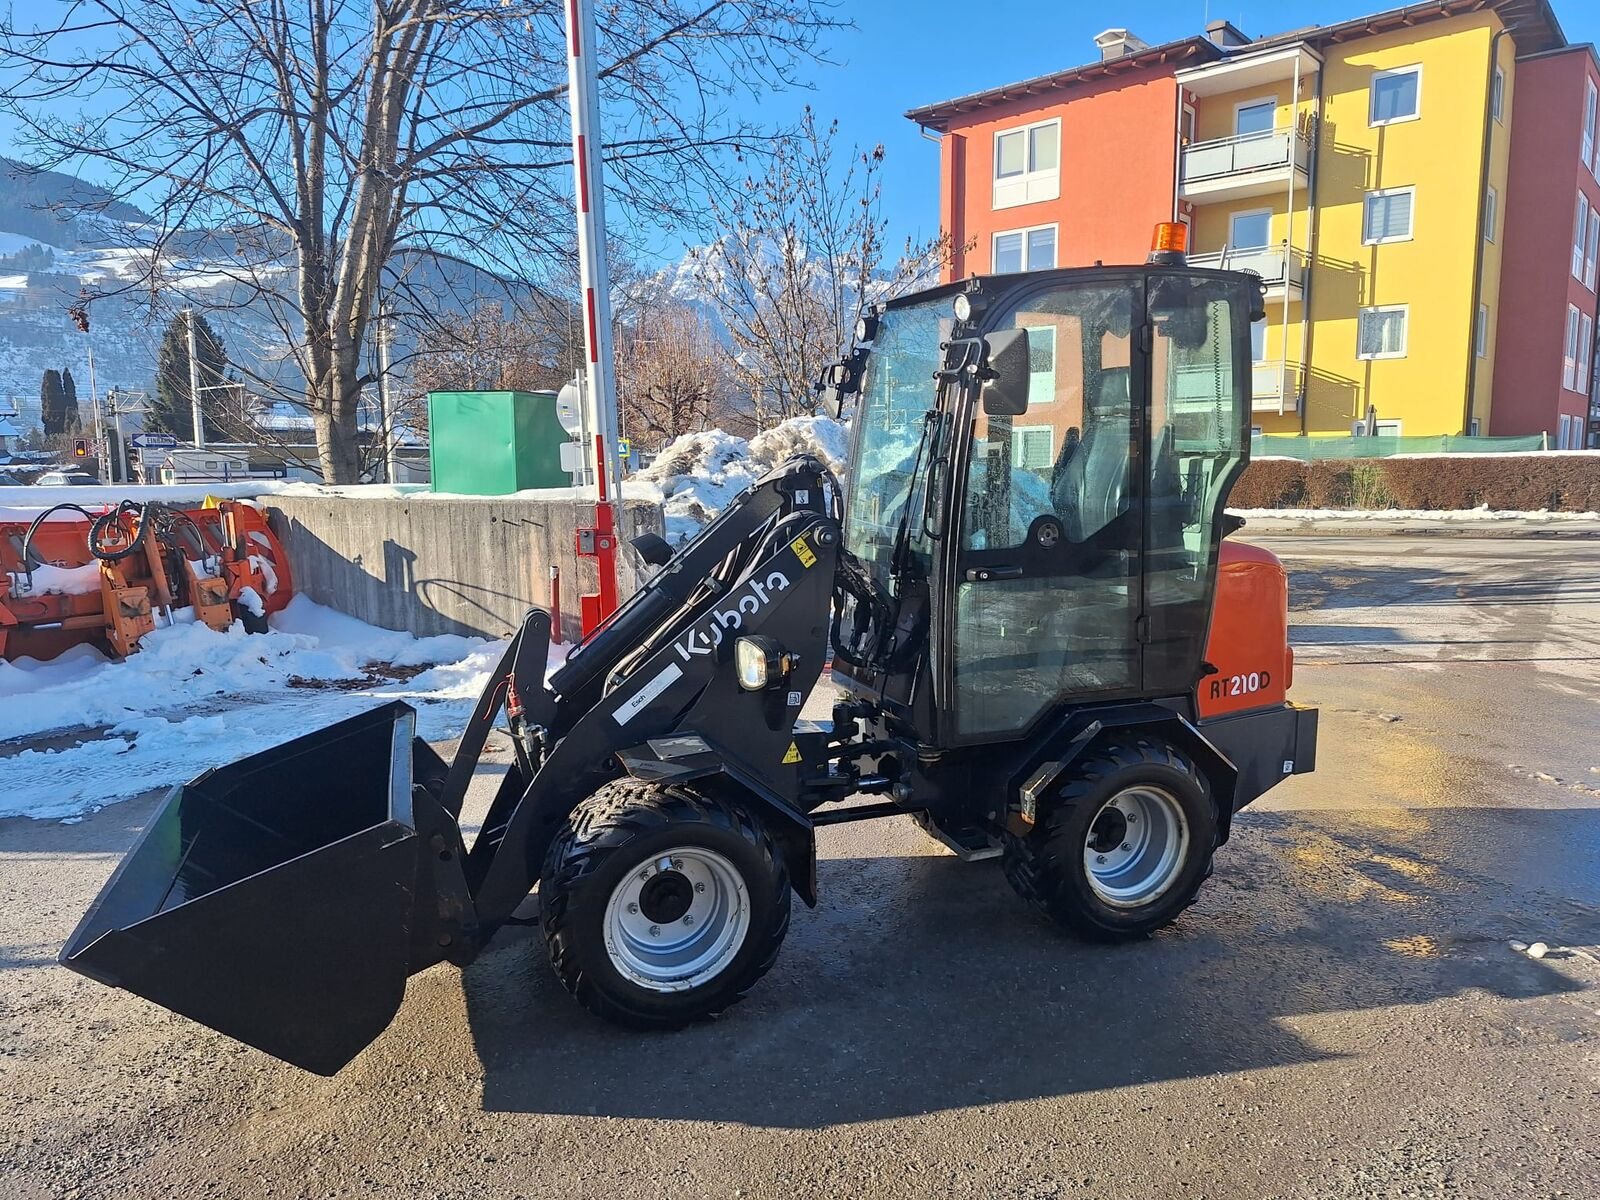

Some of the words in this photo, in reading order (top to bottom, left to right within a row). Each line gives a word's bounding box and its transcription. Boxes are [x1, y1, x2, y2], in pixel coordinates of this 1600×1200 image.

[673, 571, 790, 661] Kubota
[1210, 671, 1271, 700] RT210D
[631, 694, 647, 708] Esch
